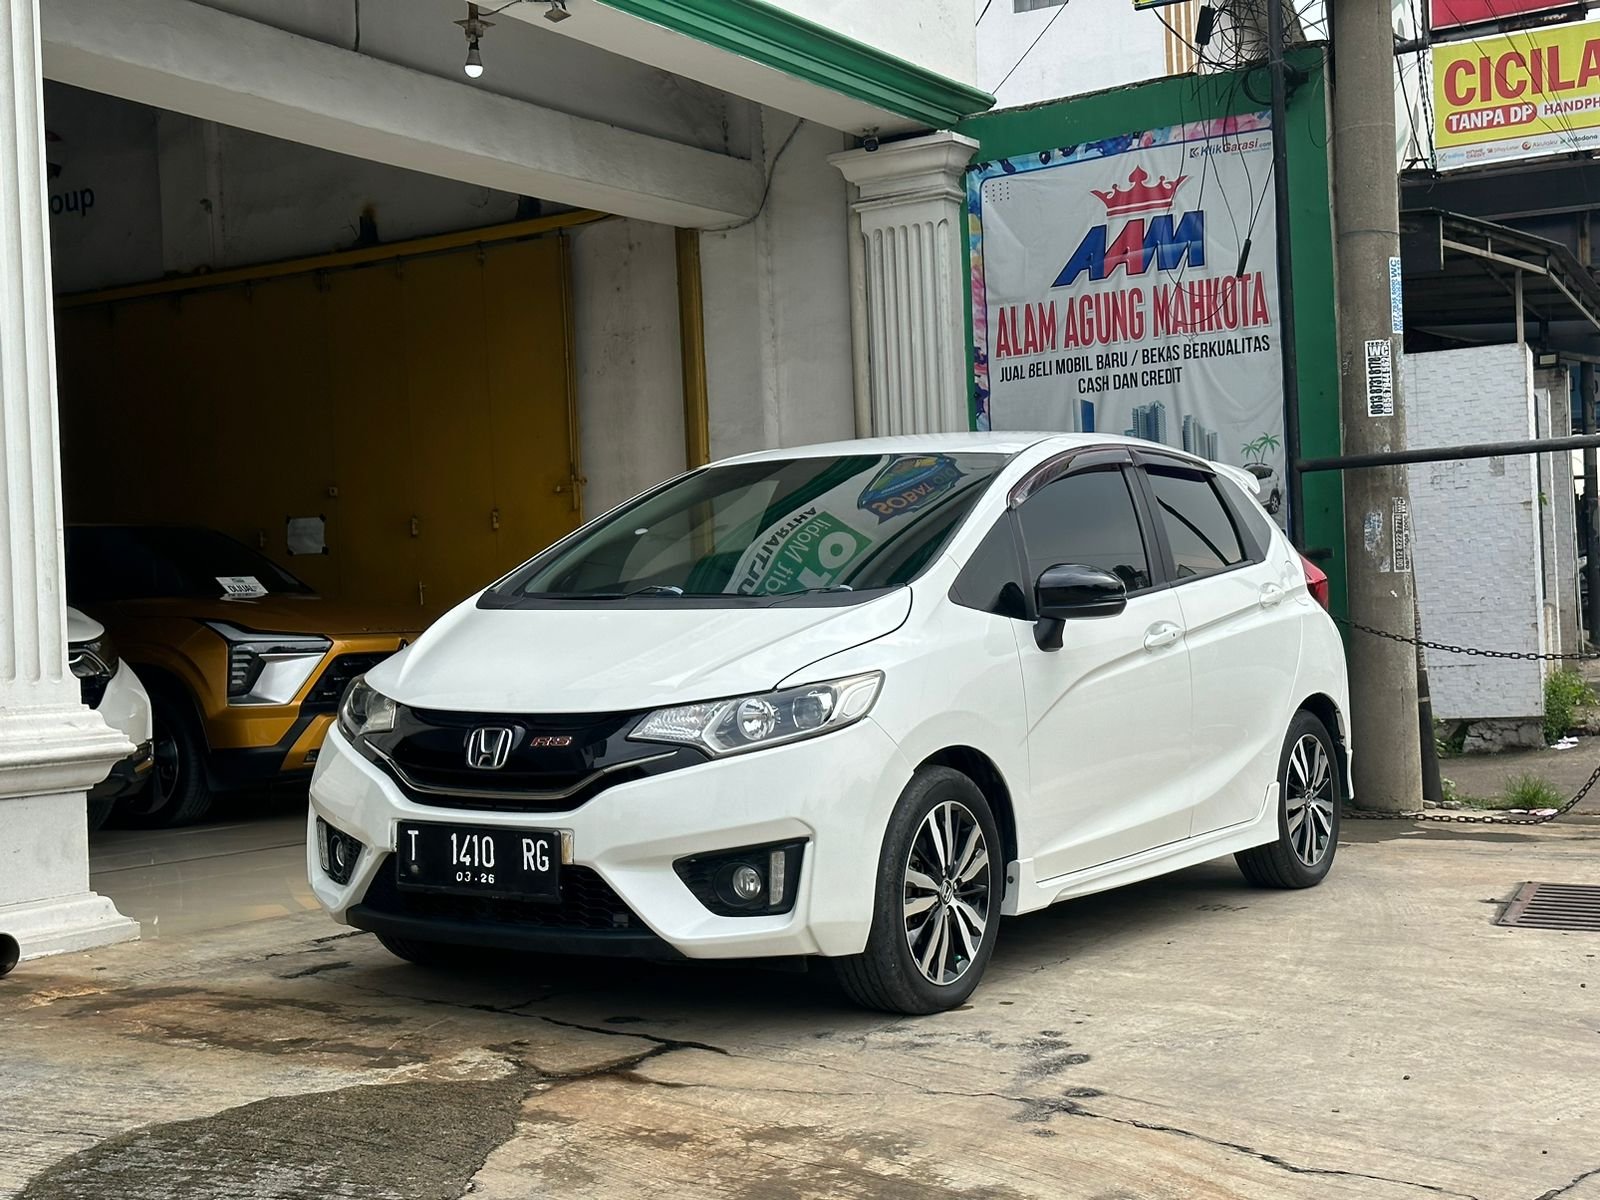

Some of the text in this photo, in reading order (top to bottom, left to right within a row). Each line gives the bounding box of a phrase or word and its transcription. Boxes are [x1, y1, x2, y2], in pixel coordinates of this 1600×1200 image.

[1448, 104, 1534, 132] TANPA DP
[1544, 96, 1600, 115] HANDPH
[1050, 210, 1206, 288] AAM
[995, 270, 1270, 358] ALAM AGUNG MAHKOTA
[1000, 364, 1026, 382] JUAL
[1028, 360, 1053, 379] BELI
[1055, 355, 1093, 375] MOBIL
[1096, 351, 1128, 371] BARU
[1142, 344, 1180, 365] BEKAS
[1183, 334, 1271, 359] BERKUALITAS
[1368, 345, 1390, 357] WC
[1078, 366, 1183, 394] CASH DAN CREDIT
[407, 829, 550, 872] T 1410 RG
